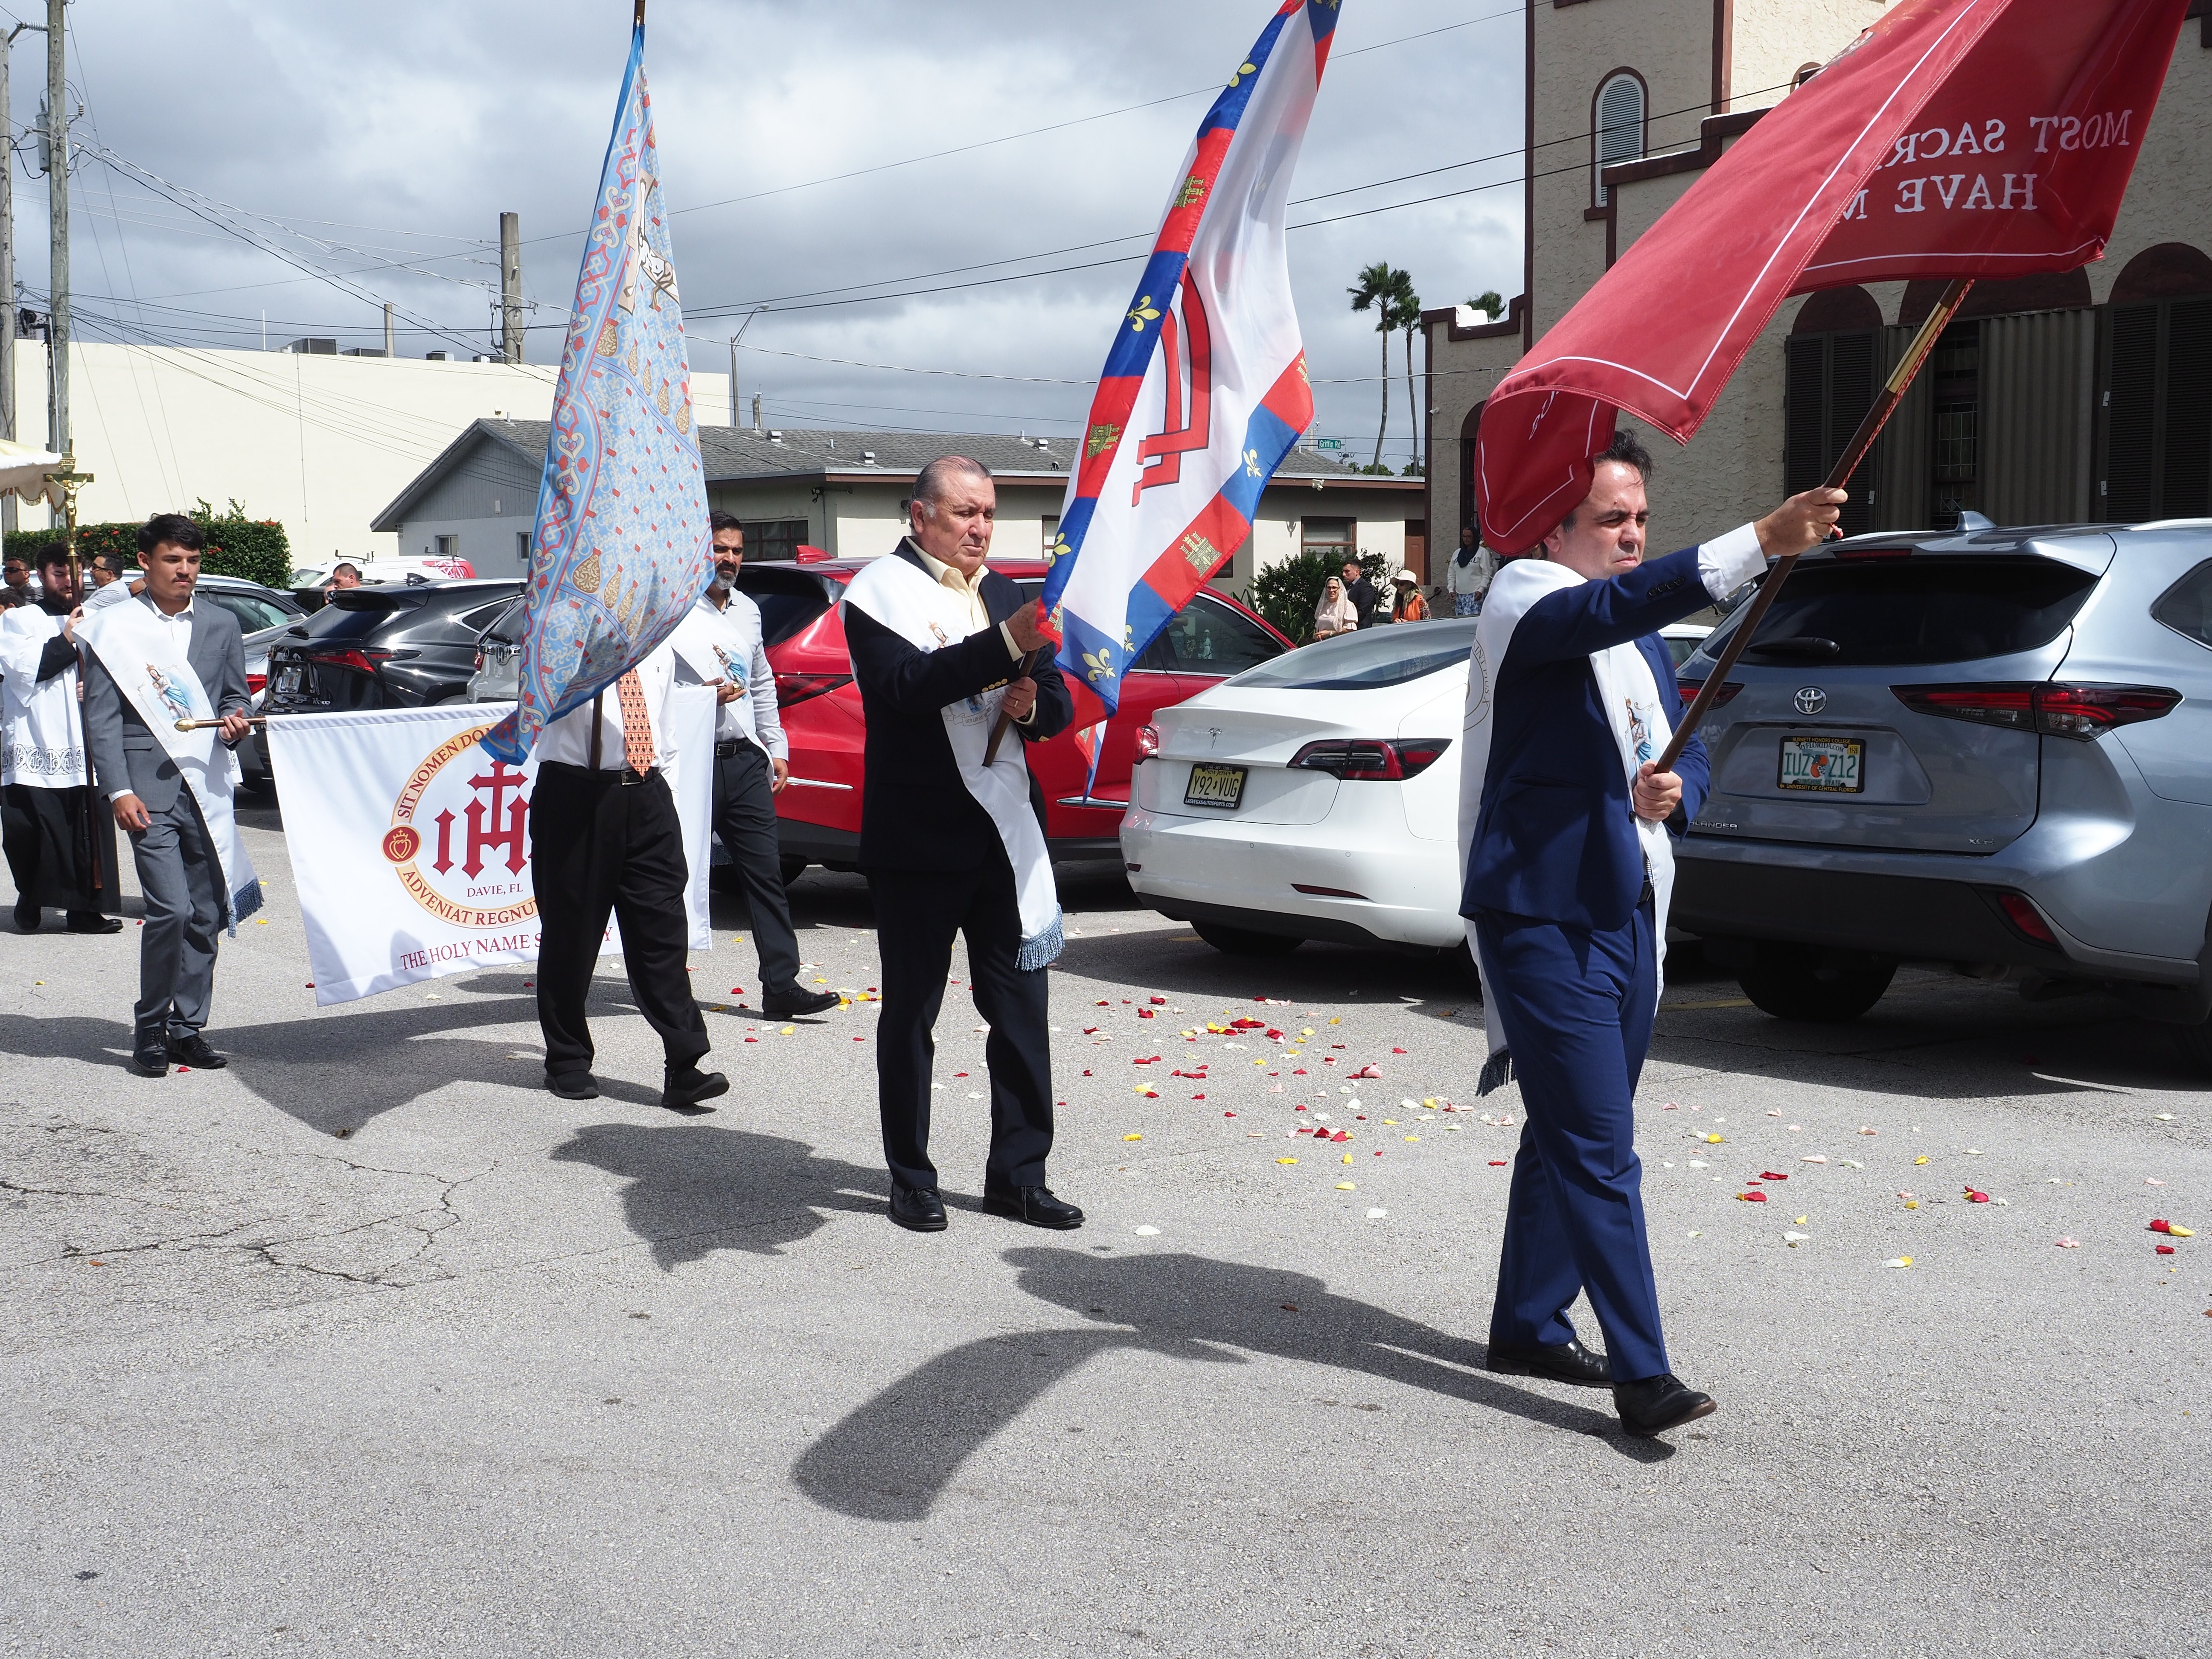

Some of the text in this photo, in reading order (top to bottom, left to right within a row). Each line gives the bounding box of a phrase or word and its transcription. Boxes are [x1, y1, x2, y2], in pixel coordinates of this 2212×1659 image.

[1799, 742, 1844, 752] MYFLORIDA.COM
[1784, 753, 1856, 778] IUZ Z12
[398, 793, 416, 818] SIT
[409, 741, 459, 793] NOMEN
[1193, 775, 1239, 797] Y92 VUG
[1185, 798, 1235, 808] LASVEGASAUTOSPORTS.COM
[403, 871, 538, 925] ADVENIAT REGNU
[467, 883, 524, 897] DAVIE, FL
[400, 950, 427, 970] THE
[428, 941, 472, 963] HOLY
[476, 934, 530, 954] NAME
